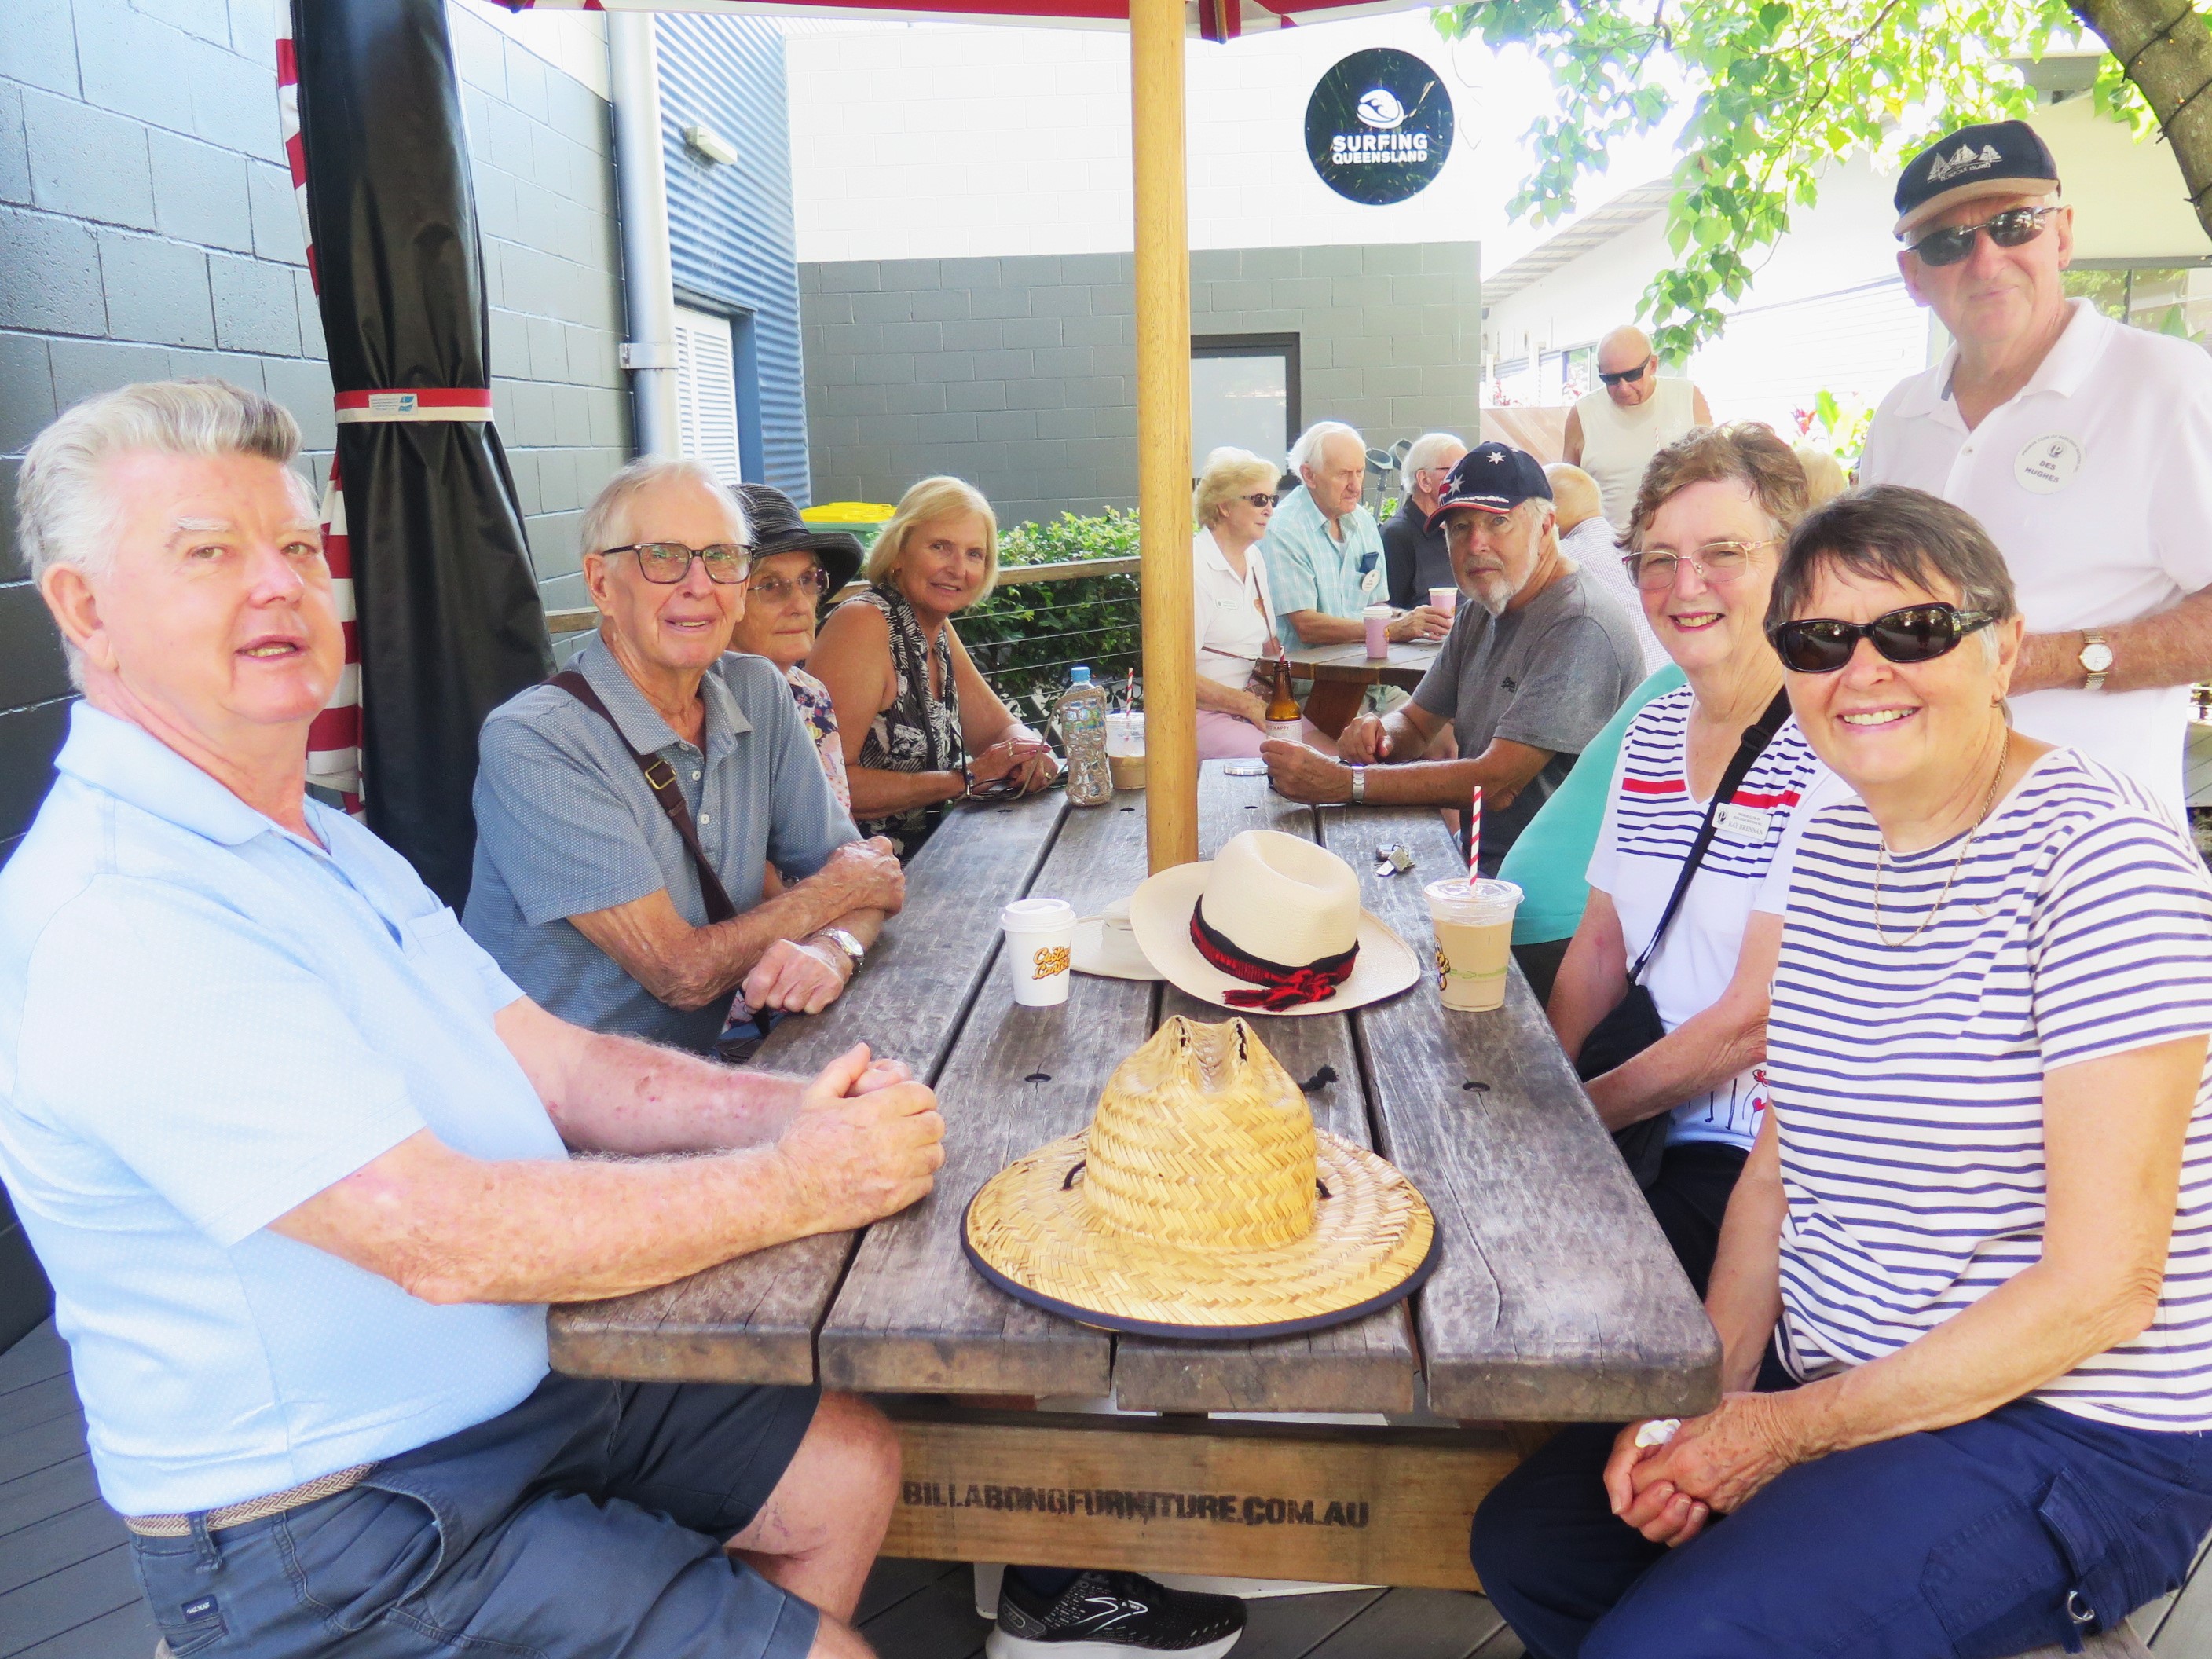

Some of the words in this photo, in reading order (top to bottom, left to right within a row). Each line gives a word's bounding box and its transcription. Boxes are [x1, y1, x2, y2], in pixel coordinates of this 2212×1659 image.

[1332, 133, 1428, 152] SURFING
[1332, 150, 1428, 165] QUEENSLAND
[1940, 167, 1968, 182] NORFOLK
[1968, 162, 1992, 170] ISLAND
[2024, 466, 2060, 483] HUGHES
[2038, 460, 2056, 471] DES
[903, 1481, 1369, 1529] BILLABONGFURNITURE.COM.AU
